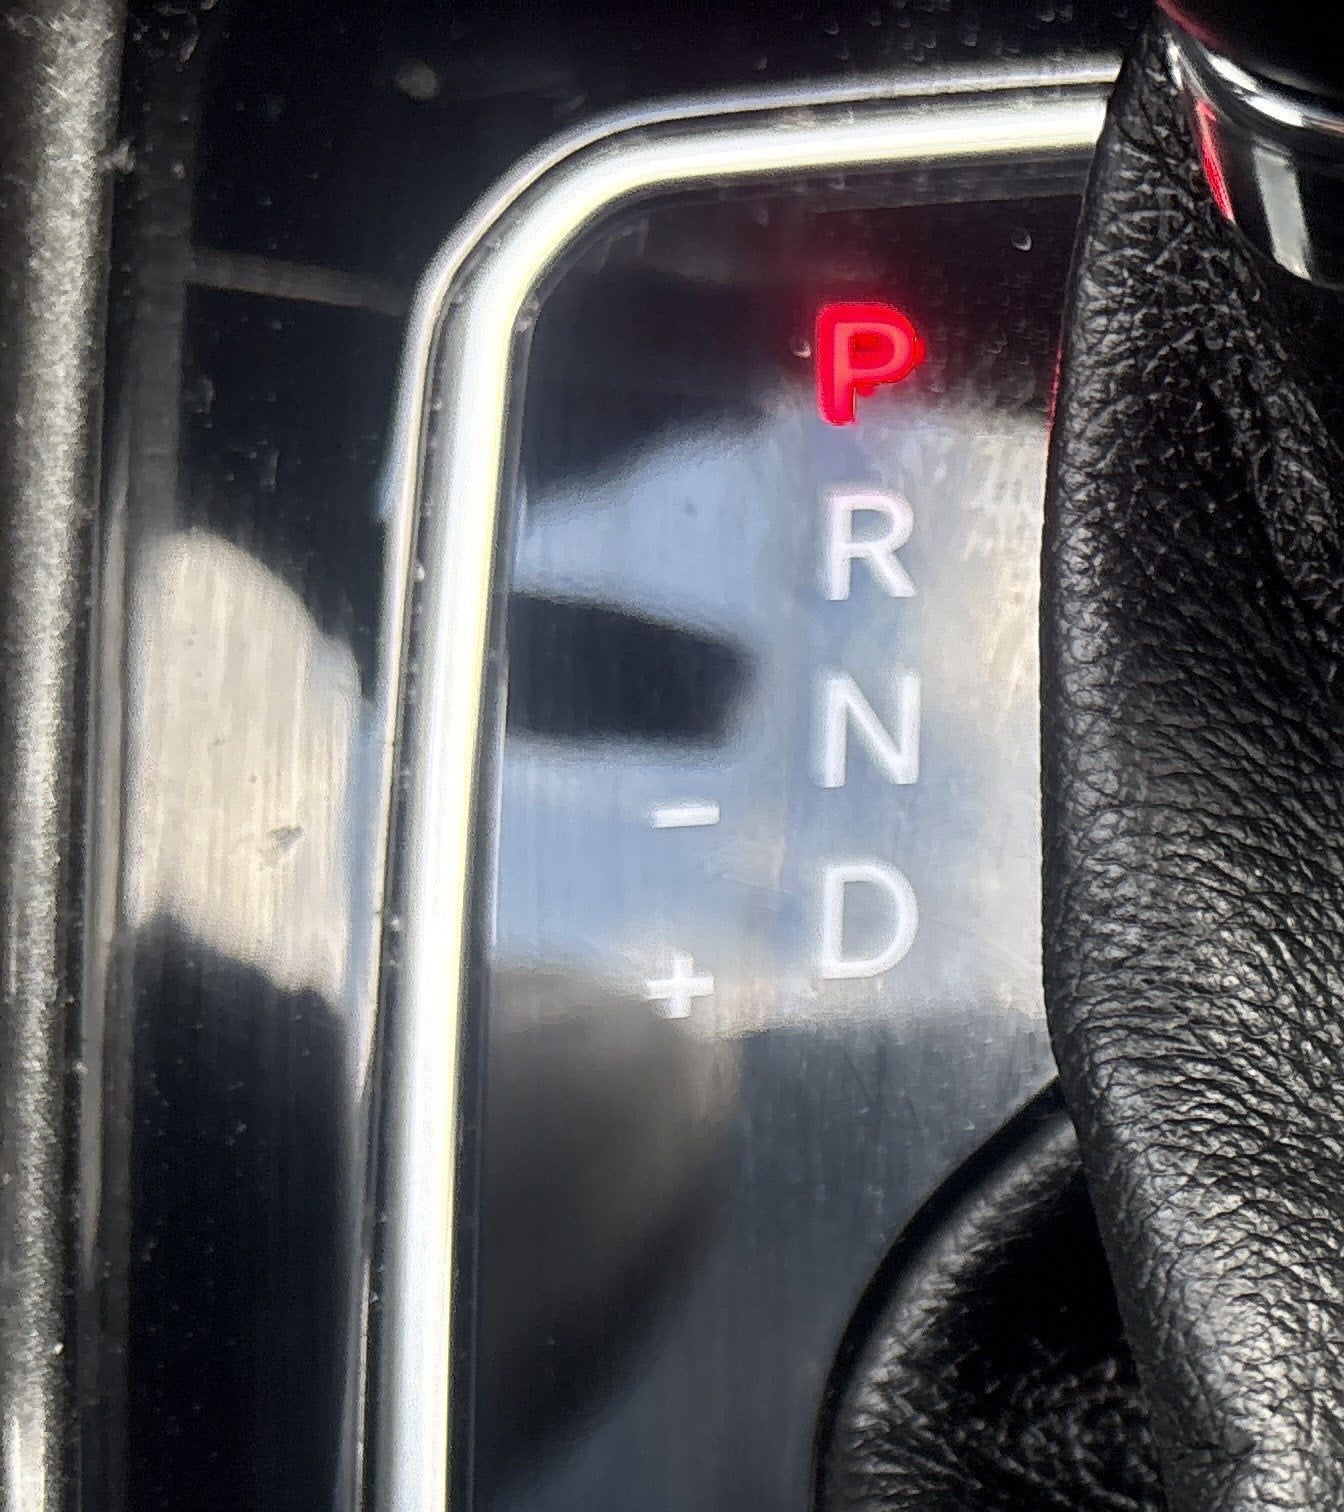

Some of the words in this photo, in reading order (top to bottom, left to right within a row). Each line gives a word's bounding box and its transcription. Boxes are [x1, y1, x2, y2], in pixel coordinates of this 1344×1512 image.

[815, 302, 925, 427] P
[828, 484, 918, 602] R
[817, 670, 921, 789] N
[818, 859, 919, 980] D
